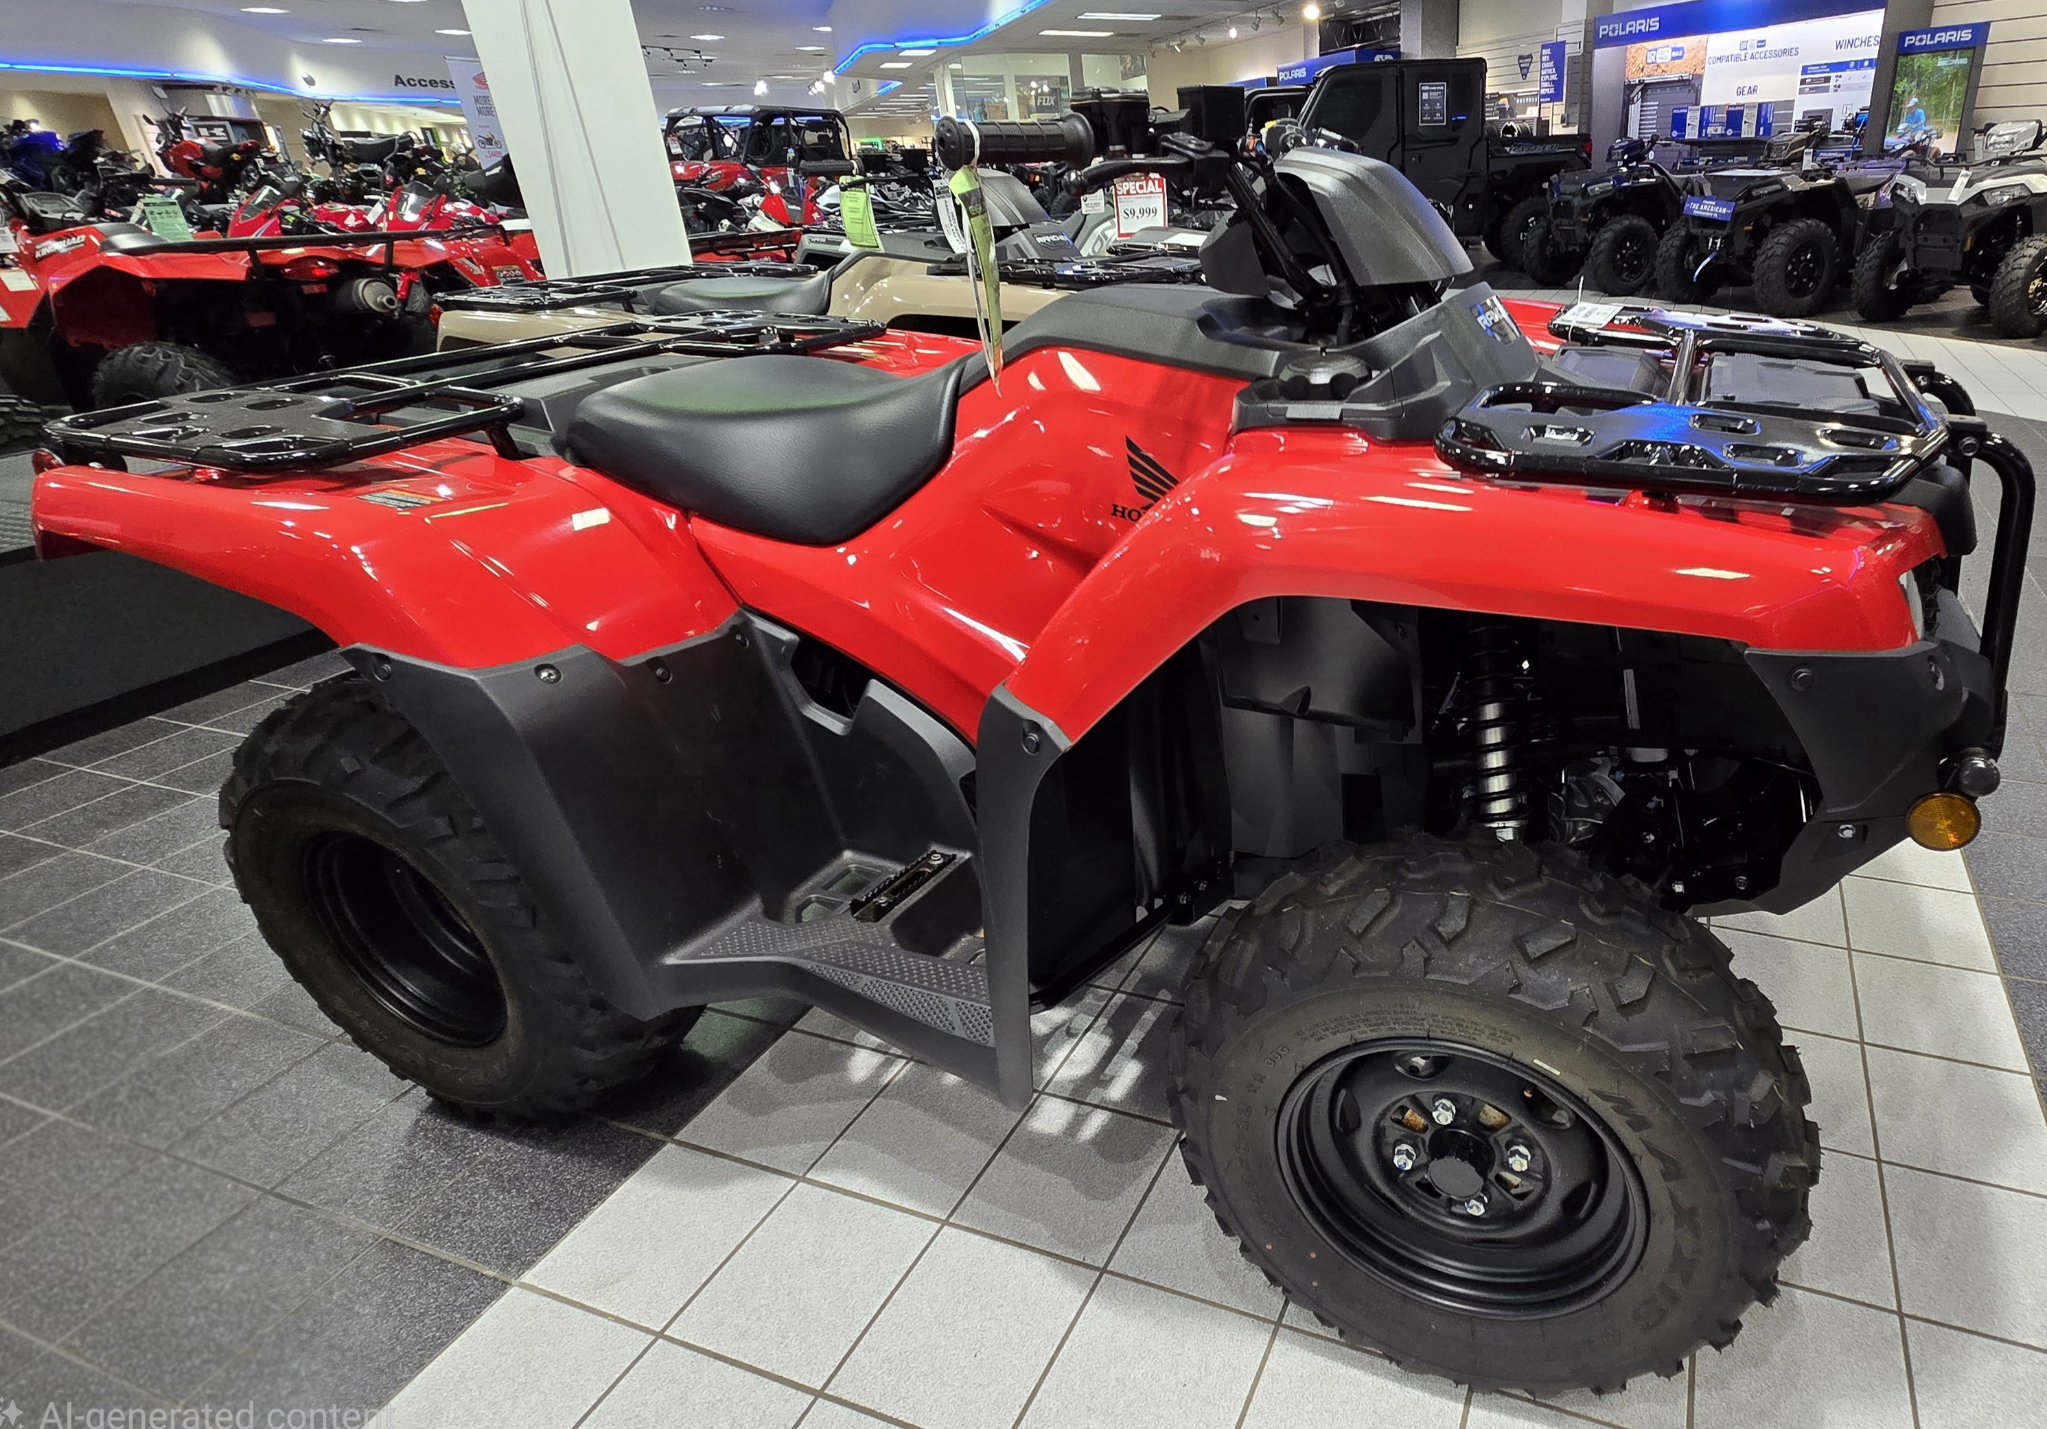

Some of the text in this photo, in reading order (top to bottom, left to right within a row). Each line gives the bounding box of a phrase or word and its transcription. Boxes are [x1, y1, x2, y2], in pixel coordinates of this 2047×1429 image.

[1599, 17, 1660, 38] POLARIS
[1835, 35, 1880, 51] WINCHES
[1904, 29, 1972, 47] POLARIS
[1707, 47, 1800, 65] COMPATIBLE ACCESSORIES
[1279, 67, 1307, 81] POLARIS
[1736, 85, 1758, 96] GEAR
[1037, 95, 1056, 106] FOX
[1116, 179, 1163, 195] SPECIAL
[1123, 207, 1158, 220] $9,999
